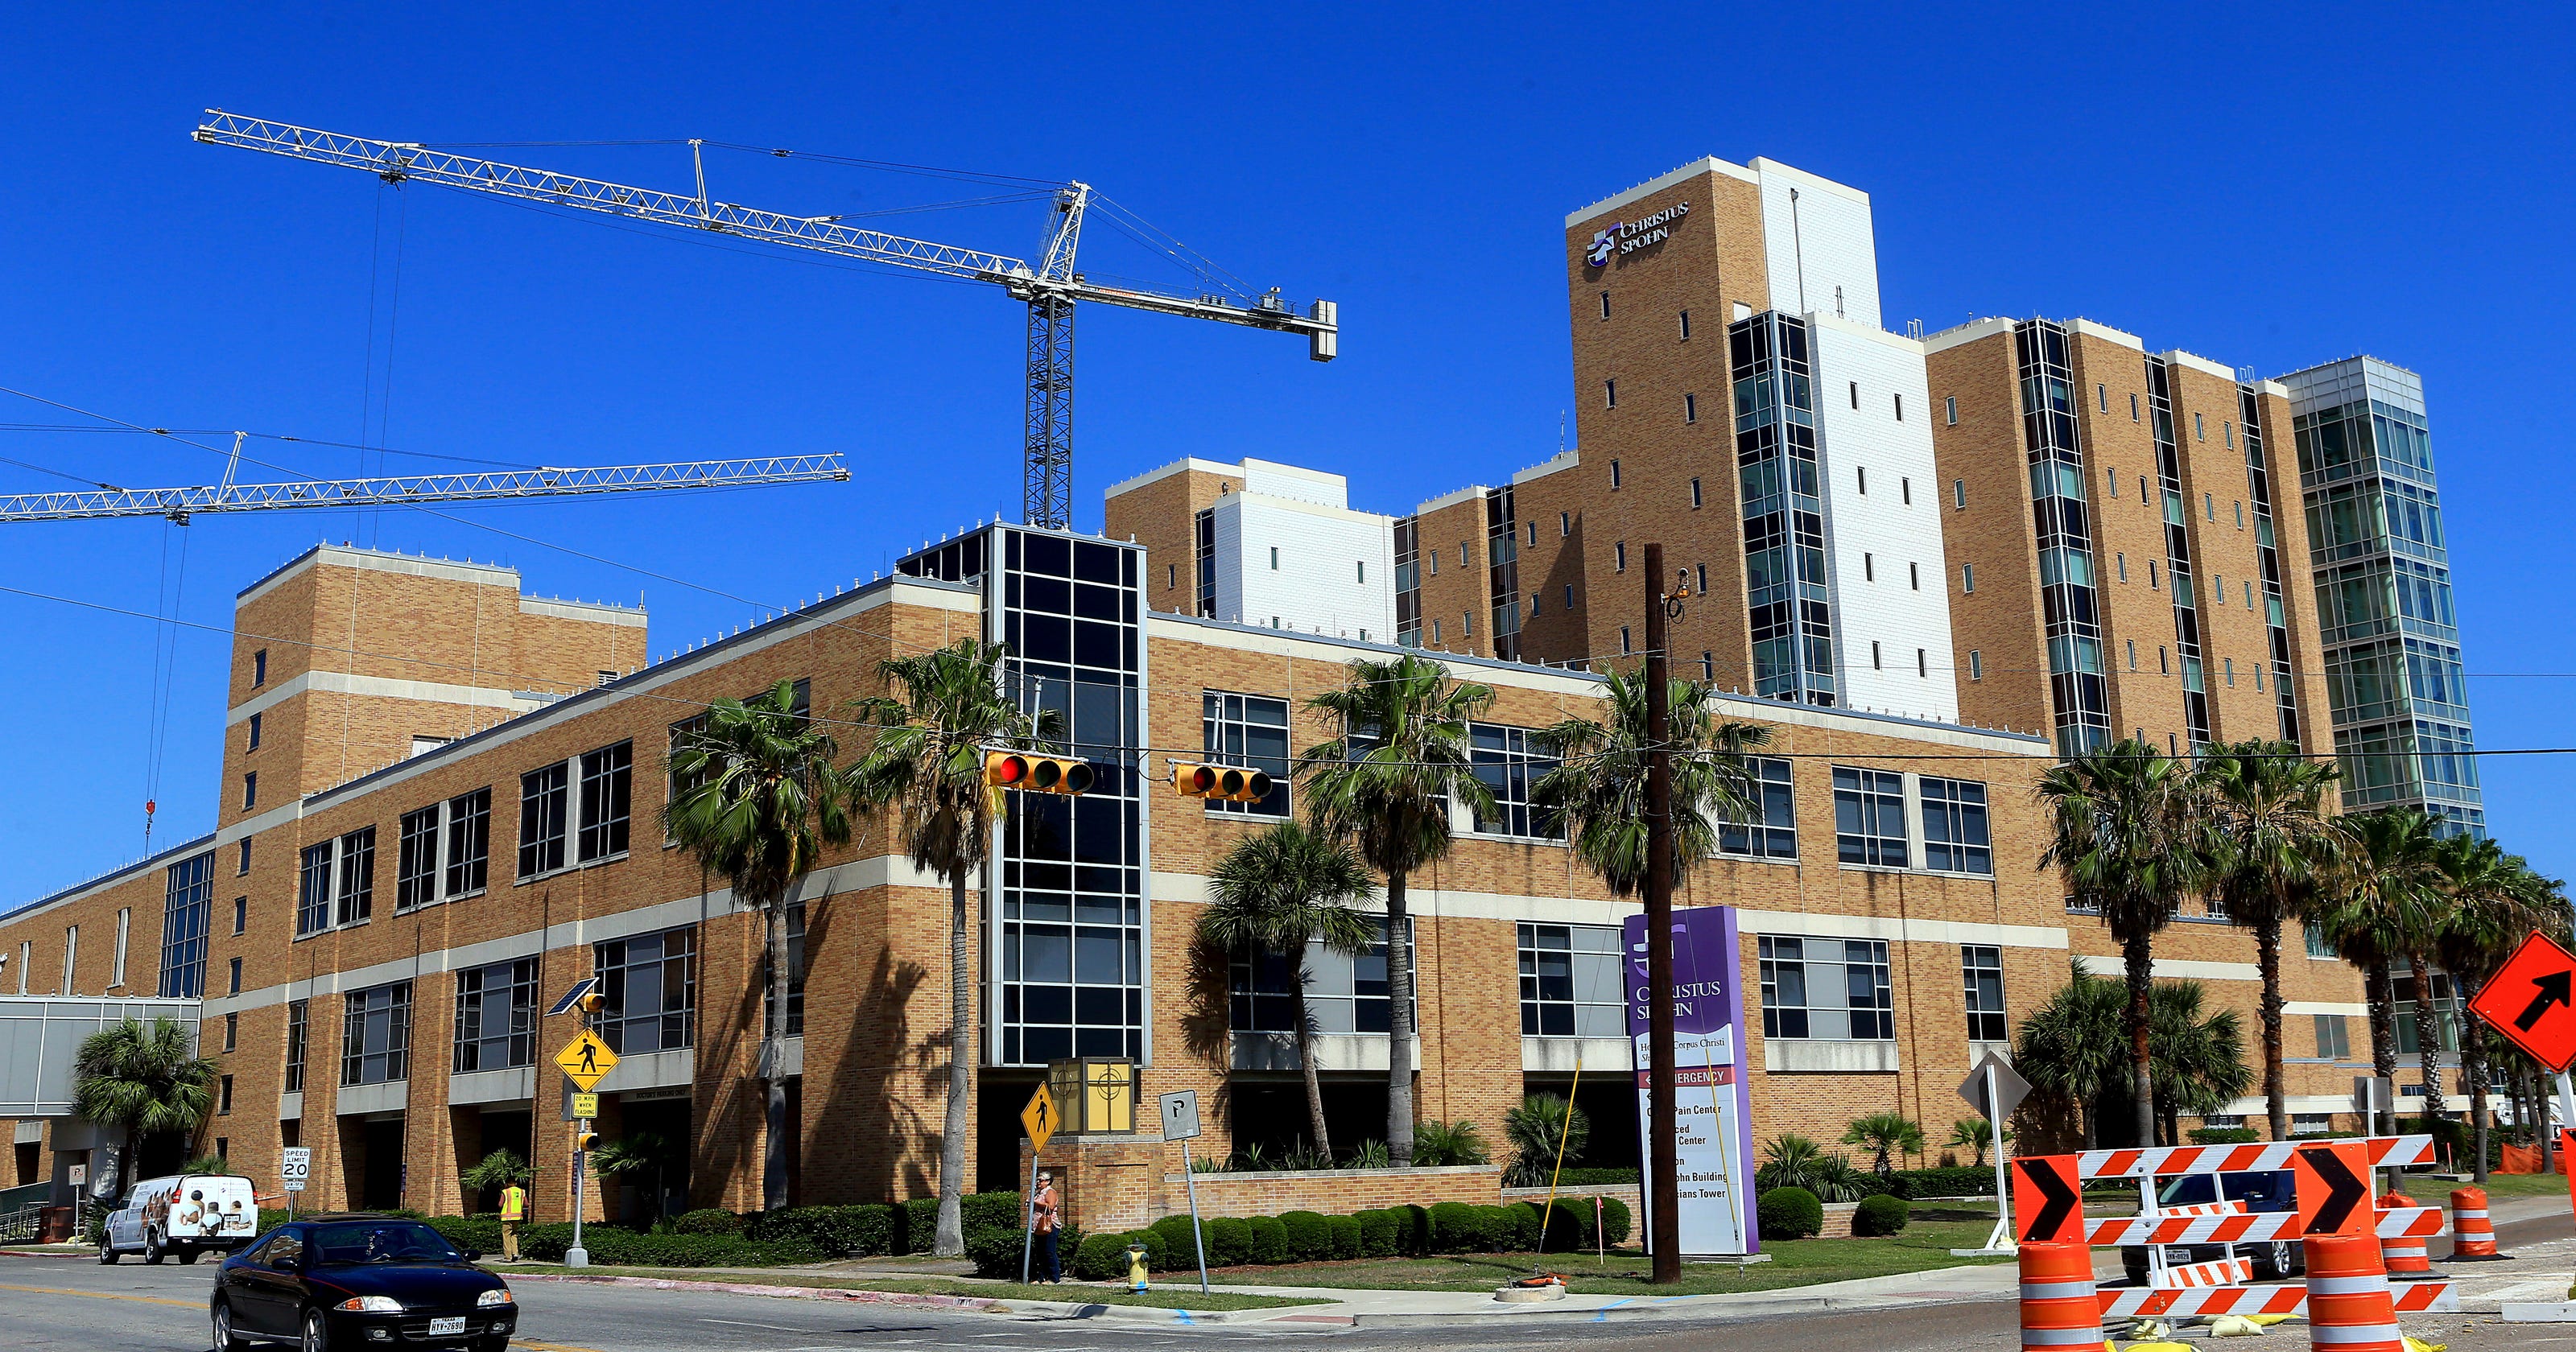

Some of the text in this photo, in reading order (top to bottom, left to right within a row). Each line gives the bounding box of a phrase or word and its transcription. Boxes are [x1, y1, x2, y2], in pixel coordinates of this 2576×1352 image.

[1620, 201, 1689, 238] CHRISTUS
[1620, 225, 1669, 254] SPOHN
[1636, 981, 1721, 1002] CISTUS
[1674, 1038, 1725, 1050] Corpus Christi
[1674, 1071, 1724, 1084] ERGENCY
[1172, 1099, 1185, 1118] P
[1694, 1105, 1722, 1115] Center
[1678, 1136, 1706, 1145] Center
[283, 1163, 308, 1176] 20
[1692, 1172, 1728, 1183] Building
[1699, 1189, 1725, 1198] Tower
